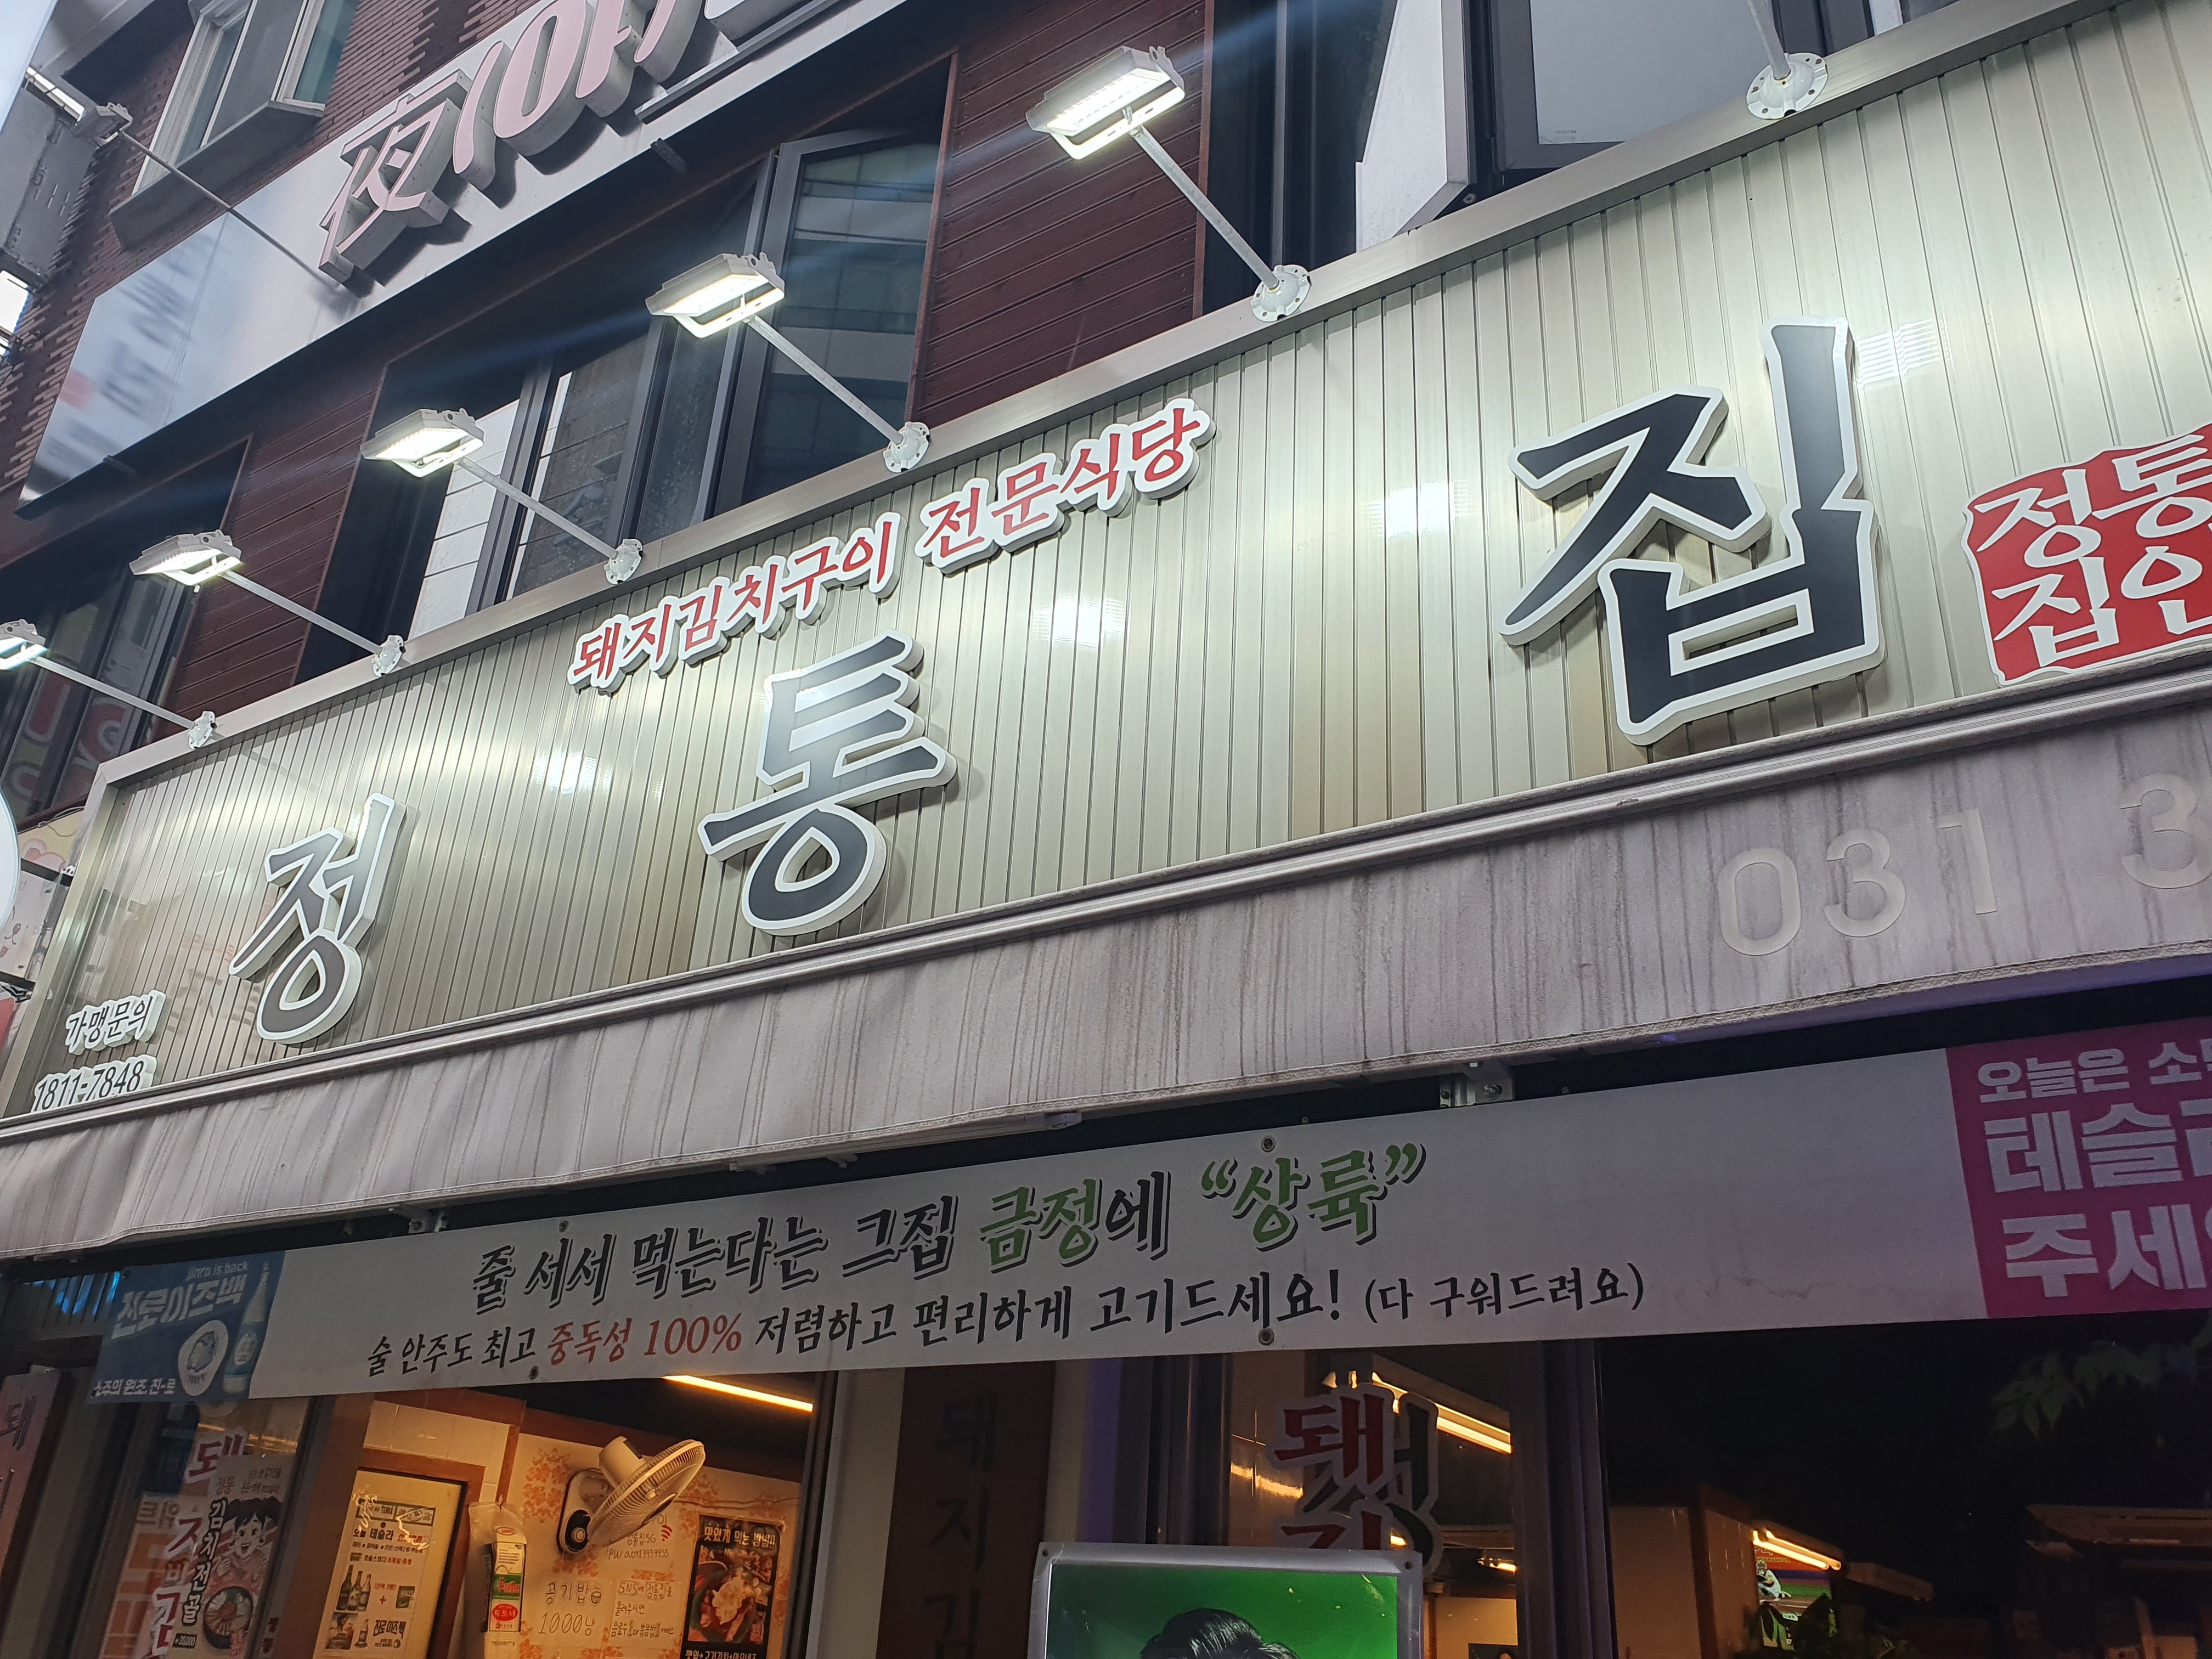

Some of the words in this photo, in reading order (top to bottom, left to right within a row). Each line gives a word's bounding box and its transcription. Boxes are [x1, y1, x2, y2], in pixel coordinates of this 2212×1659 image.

[1973, 433, 2212, 568] 정통
[569, 517, 897, 688] 돼지김치구이
[919, 403, 1205, 563] 전문식당
[1718, 806, 1997, 956] 031
[67, 994, 154, 1047] 가맹문의
[34, 1060, 145, 1112] 1811-7848
[1977, 1048, 2131, 1104] 오늘은
[2148, 1037, 2212, 1086] 소
[213, 1264, 222, 1276] is
[224, 1261, 250, 1274] back
[473, 1245, 516, 1316] 줄
[523, 1233, 617, 1309] 서서
[632, 1216, 830, 1300] 먹는다는
[842, 1195, 959, 1281] 그집
[979, 1171, 1171, 1274] 금정에
[2001, 1203, 2212, 1299] 주세
[111, 1274, 249, 1339] 진로이즈백
[402, 1333, 473, 1375] 안주도
[481, 1325, 537, 1369] 최고
[548, 1317, 632, 1367] 중독성
[644, 1312, 743, 1357] 100%
[754, 1301, 897, 1355] 저렴하고
[912, 1284, 1072, 1347] 편리하게
[1089, 1269, 1341, 1335] 고기드세요!
[1364, 1278, 1414, 1324] (다
[1429, 1262, 1645, 1318] 구워드려요)
[183, 1498, 227, 1624] 김치전골
[704, 1525, 732, 1543] 맛있게
[734, 1530, 751, 1546] 먹는
[545, 1582, 589, 1605] 공기밥
